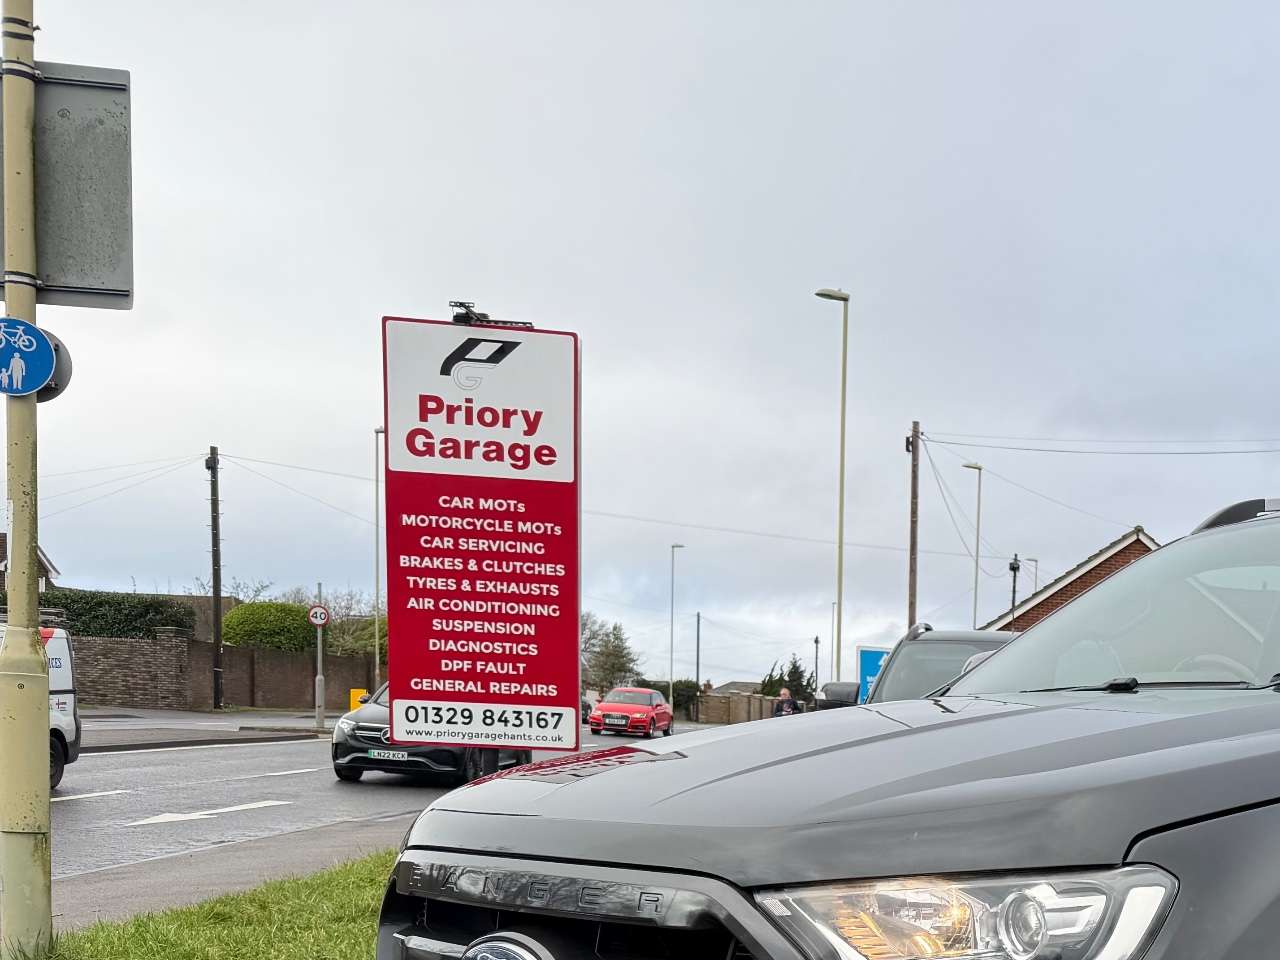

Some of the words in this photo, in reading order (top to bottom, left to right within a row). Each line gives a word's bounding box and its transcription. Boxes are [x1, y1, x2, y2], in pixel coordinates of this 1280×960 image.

[418, 394, 543, 436] Priory
[405, 428, 557, 470] Garage
[438, 496, 474, 510] CAR
[479, 498, 526, 513] MOTs
[402, 514, 514, 533] MOTORCYCLE
[517, 521, 562, 536] MOTs
[420, 536, 454, 550] CAR
[458, 538, 545, 555] SERVICING
[399, 555, 463, 571] BRAKES
[467, 559, 478, 571] &
[482, 560, 566, 576] CLUTCHES
[406, 576, 457, 591] TYRES
[461, 579, 471, 592] &
[476, 580, 560, 597] EXHAUSTS
[310, 611, 327, 621] 40
[406, 597, 435, 610] AIR
[439, 599, 560, 617] CONDITIONING
[432, 618, 536, 636] SUSPENSION
[429, 638, 538, 656] DIAGNOSTICS
[441, 659, 472, 672] DPF
[476, 661, 526, 675] FAULT
[410, 678, 486, 694] GENERAL
[489, 682, 558, 697] REPAIRS
[404, 705, 473, 726] 01329
[482, 708, 564, 730] 843167
[405, 728, 564, 743] www.priorygaragehants.co.uk
[408, 864, 664, 914] RANGER
